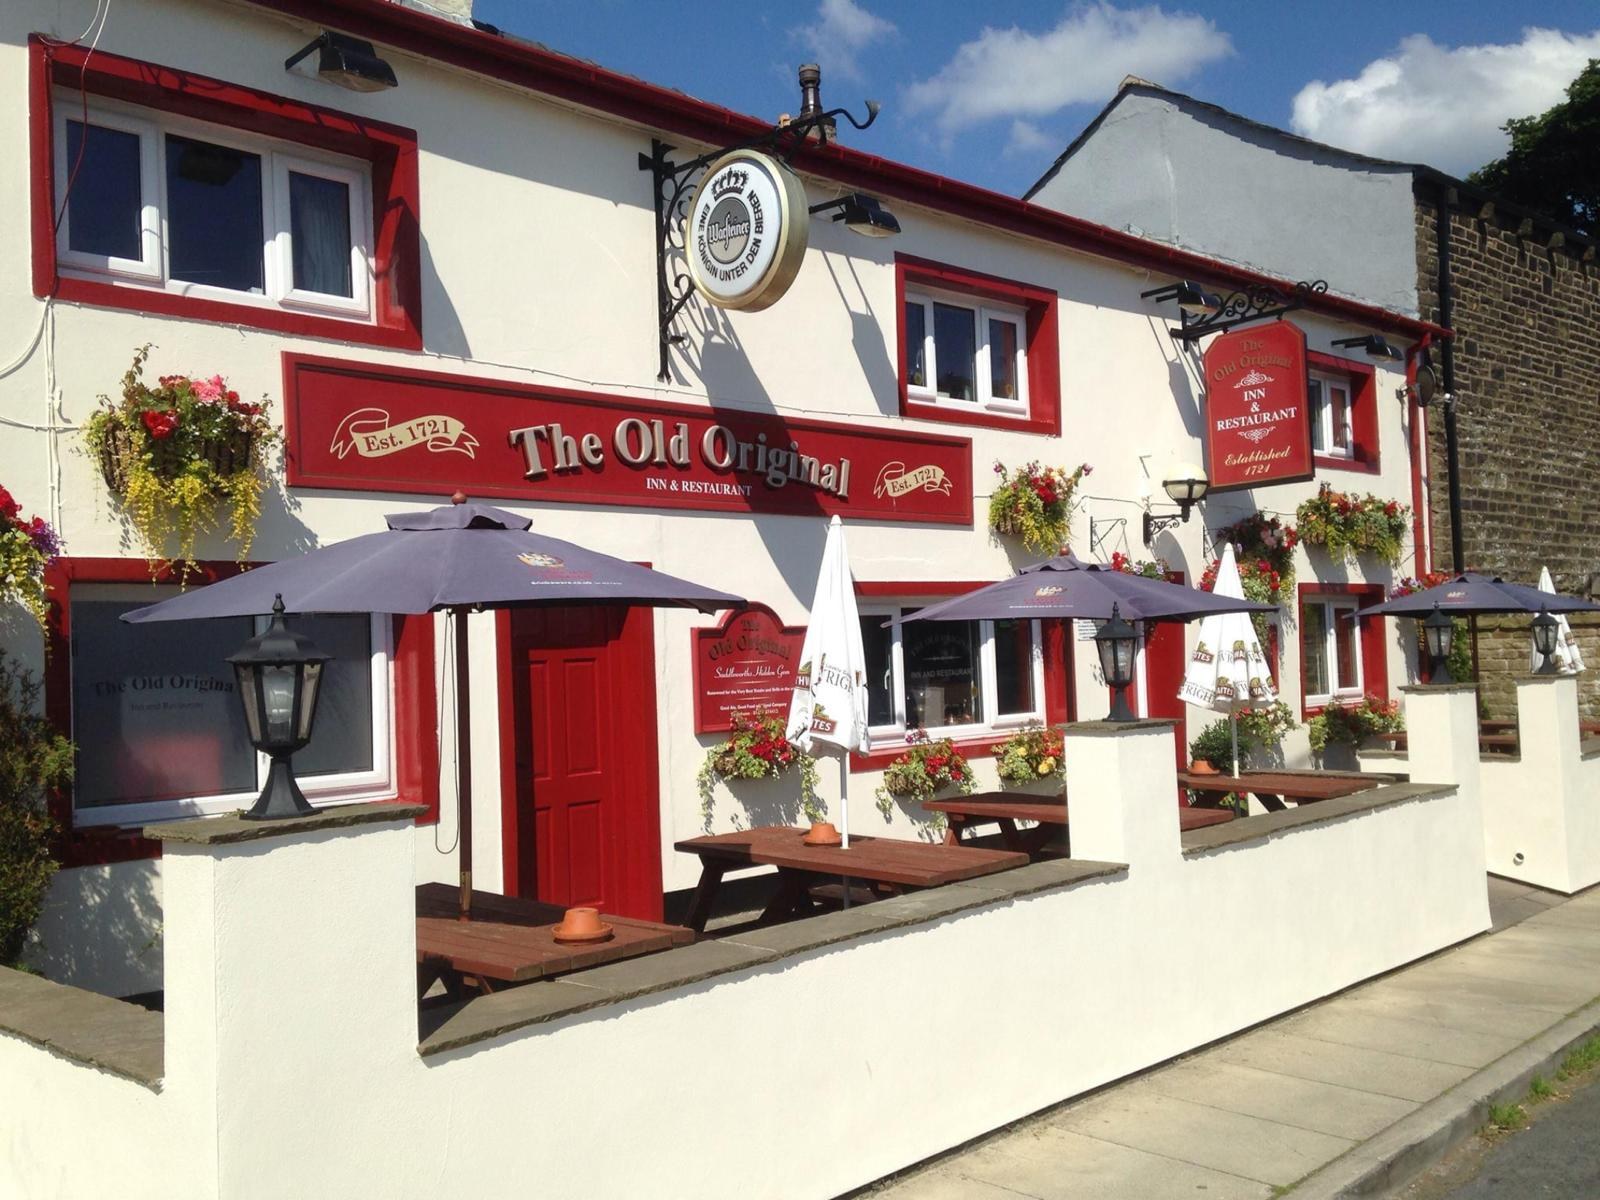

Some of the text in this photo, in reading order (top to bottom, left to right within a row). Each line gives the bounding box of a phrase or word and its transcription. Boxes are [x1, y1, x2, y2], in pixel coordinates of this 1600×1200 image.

[698, 203, 711, 232] EINE
[747, 189, 764, 235] BIEREN
[707, 211, 750, 250] Warsteiner
[746, 237, 762, 265] DEN
[719, 262, 749, 281] UNTER
[1213, 352, 1293, 382] Old Original
[1243, 387, 1266, 401] INN
[1216, 406, 1298, 431] RESTAURANT
[1250, 401, 1261, 413] &
[363, 418, 451, 453] Est. 1721
[509, 417, 850, 498] The Old Original
[1224, 445, 1292, 466] Established
[890, 469, 938, 494] Est. 1721
[1244, 463, 1271, 477] 1721
[646, 477, 753, 497] INN & RESTAURANT
[95, 674, 234, 697] The Old Origina
